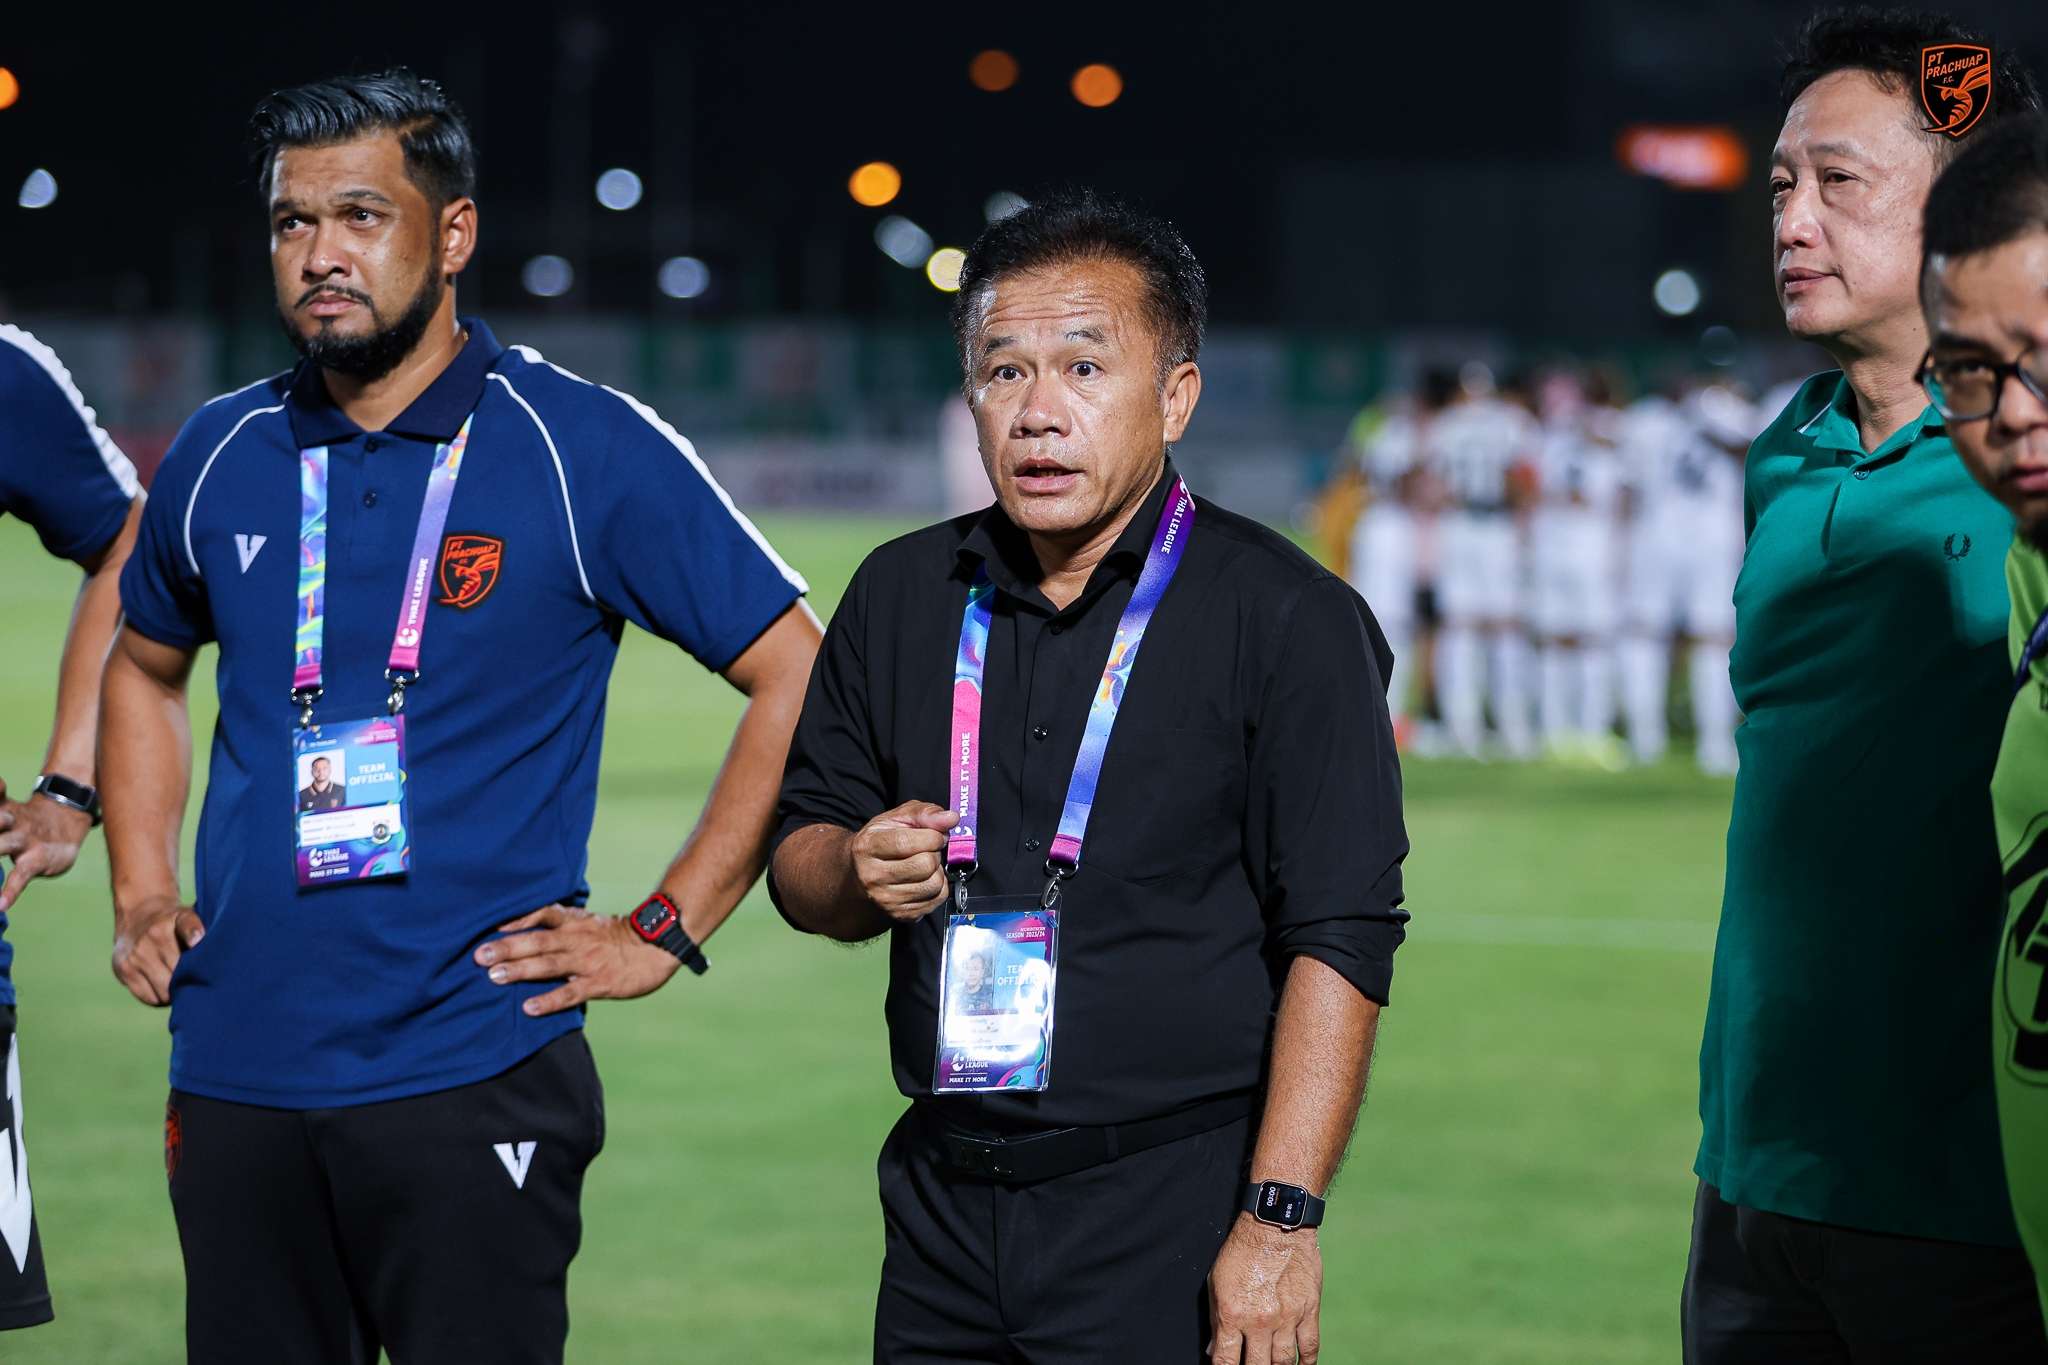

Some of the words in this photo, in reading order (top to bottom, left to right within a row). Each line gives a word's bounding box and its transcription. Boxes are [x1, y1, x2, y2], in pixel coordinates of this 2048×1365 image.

[1174, 496, 1187, 518] THAI
[1161, 519, 1180, 554] LEAGUE
[961, 732, 971, 765] MORE
[348, 771, 395, 785] OFFICIAL
[359, 763, 385, 774] TEAM
[960, 769, 970, 781] IT
[960, 784, 969, 818] MAKE
[965, 1061, 989, 1069] LEAGUE
[1267, 1187, 1276, 1206] 00:00
